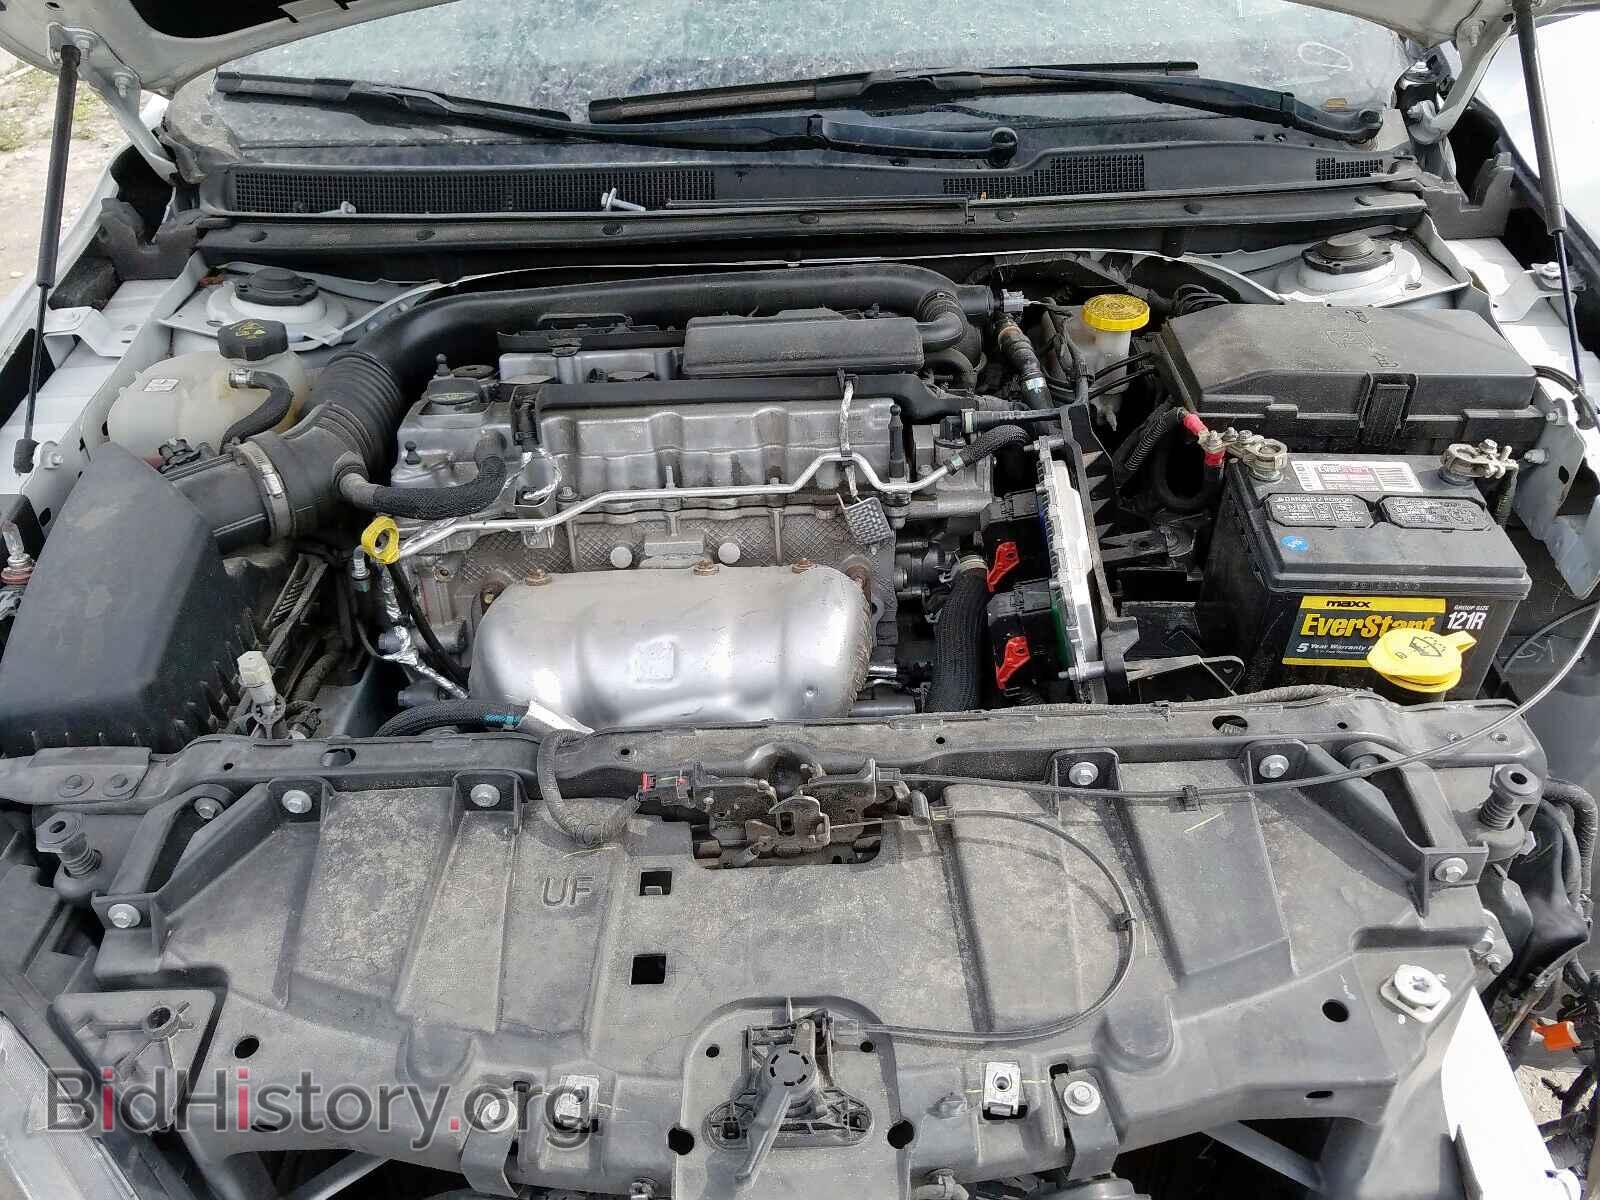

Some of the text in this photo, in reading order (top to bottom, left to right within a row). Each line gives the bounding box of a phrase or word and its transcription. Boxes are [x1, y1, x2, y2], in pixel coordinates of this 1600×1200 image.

[1326, 600, 1372, 608] maxx
[1447, 611, 1487, 630] 121R
[1296, 643, 1310, 653] 5
[542, 875, 593, 906] UF
